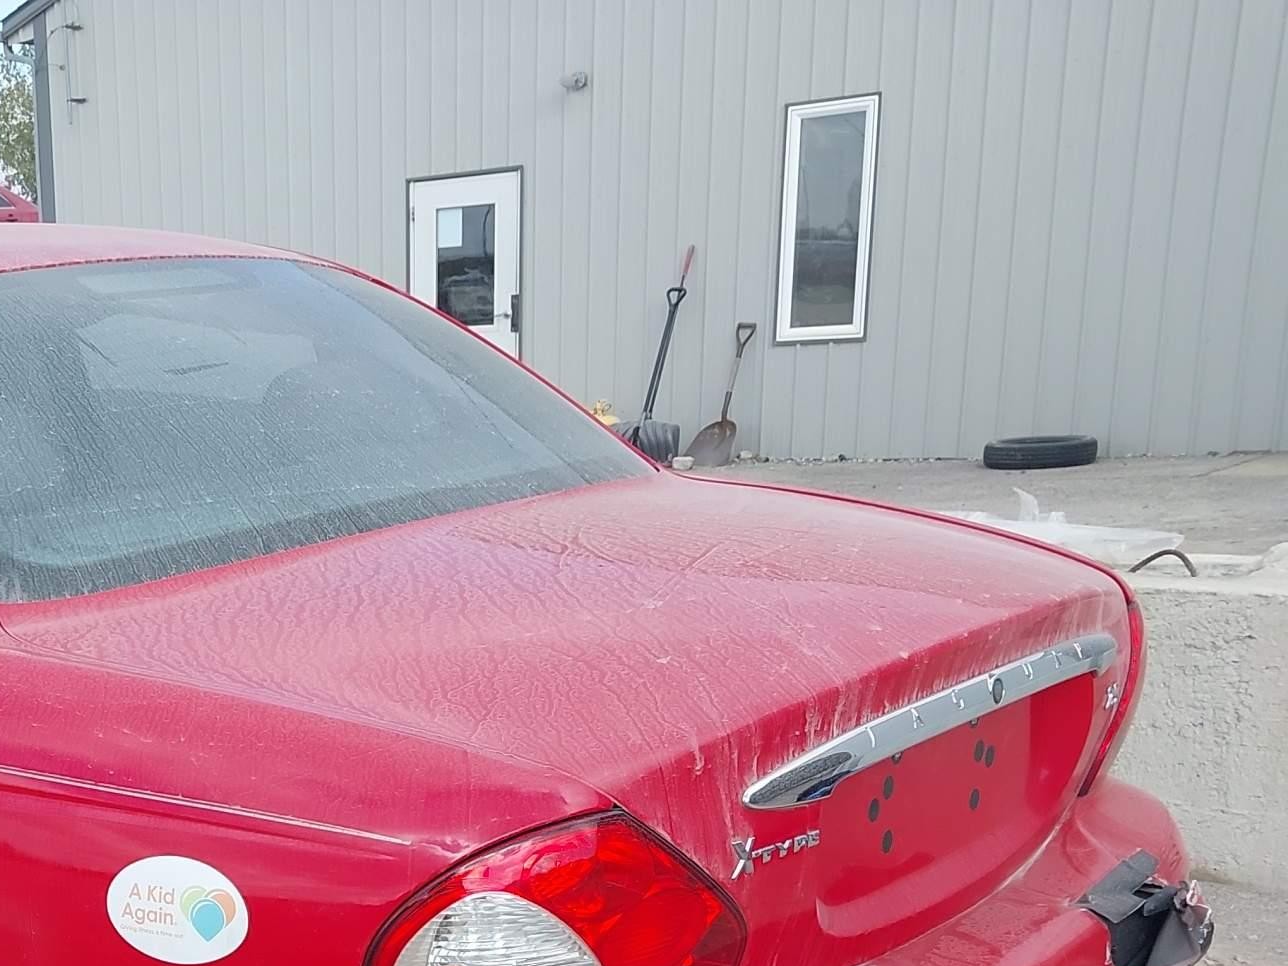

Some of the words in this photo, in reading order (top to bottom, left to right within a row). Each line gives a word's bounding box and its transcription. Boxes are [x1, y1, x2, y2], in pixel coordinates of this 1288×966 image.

[730, 828, 821, 880] X-TYPE
[128, 883, 142, 901] A
[147, 885, 176, 905] Kid
